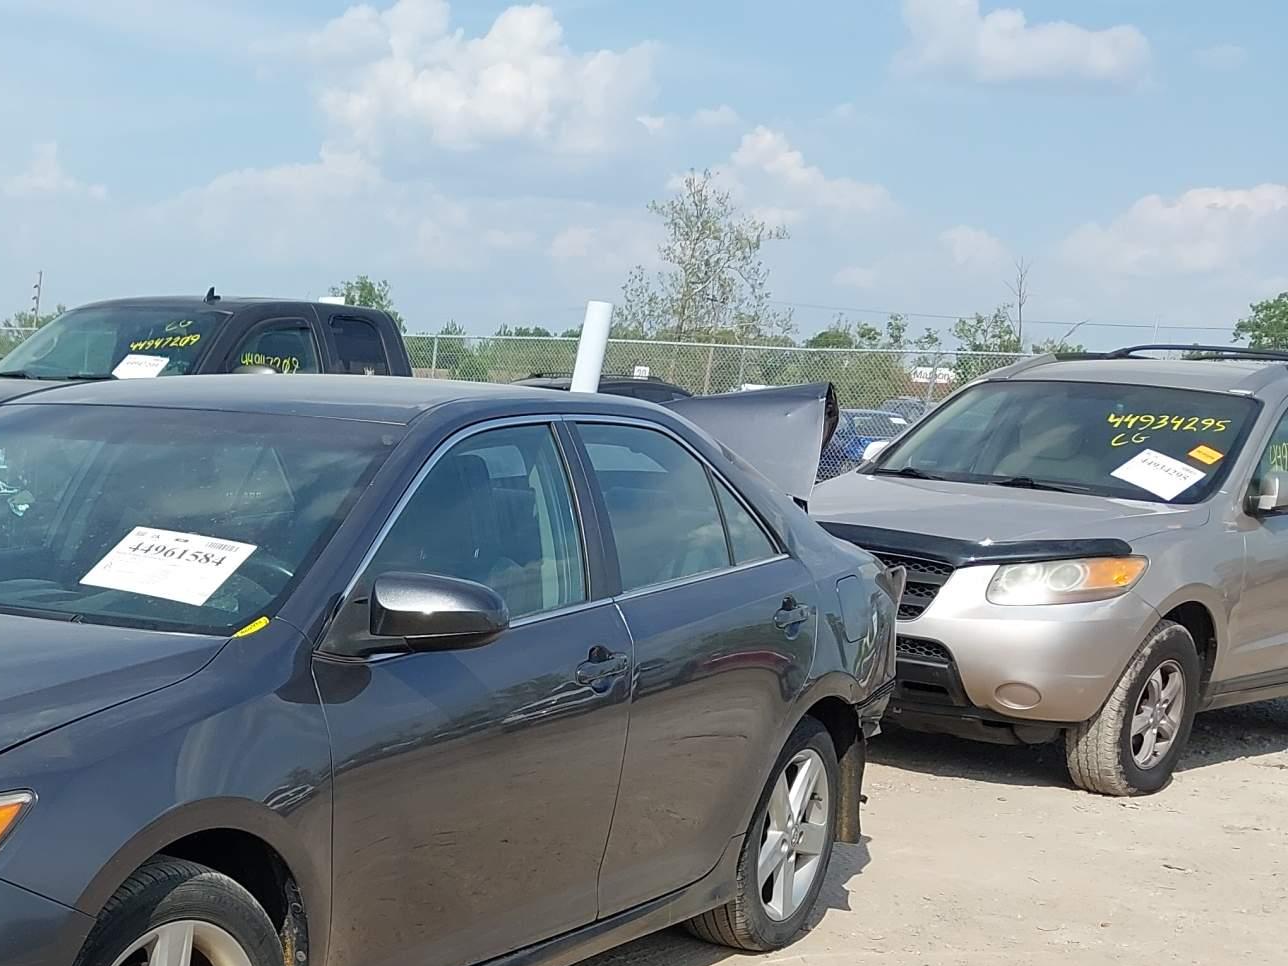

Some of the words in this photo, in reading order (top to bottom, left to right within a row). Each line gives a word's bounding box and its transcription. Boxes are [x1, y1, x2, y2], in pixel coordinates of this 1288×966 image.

[129, 333, 201, 352] 44947209
[1107, 412, 1232, 433] 44934295
[128, 541, 227, 567] 44961584
